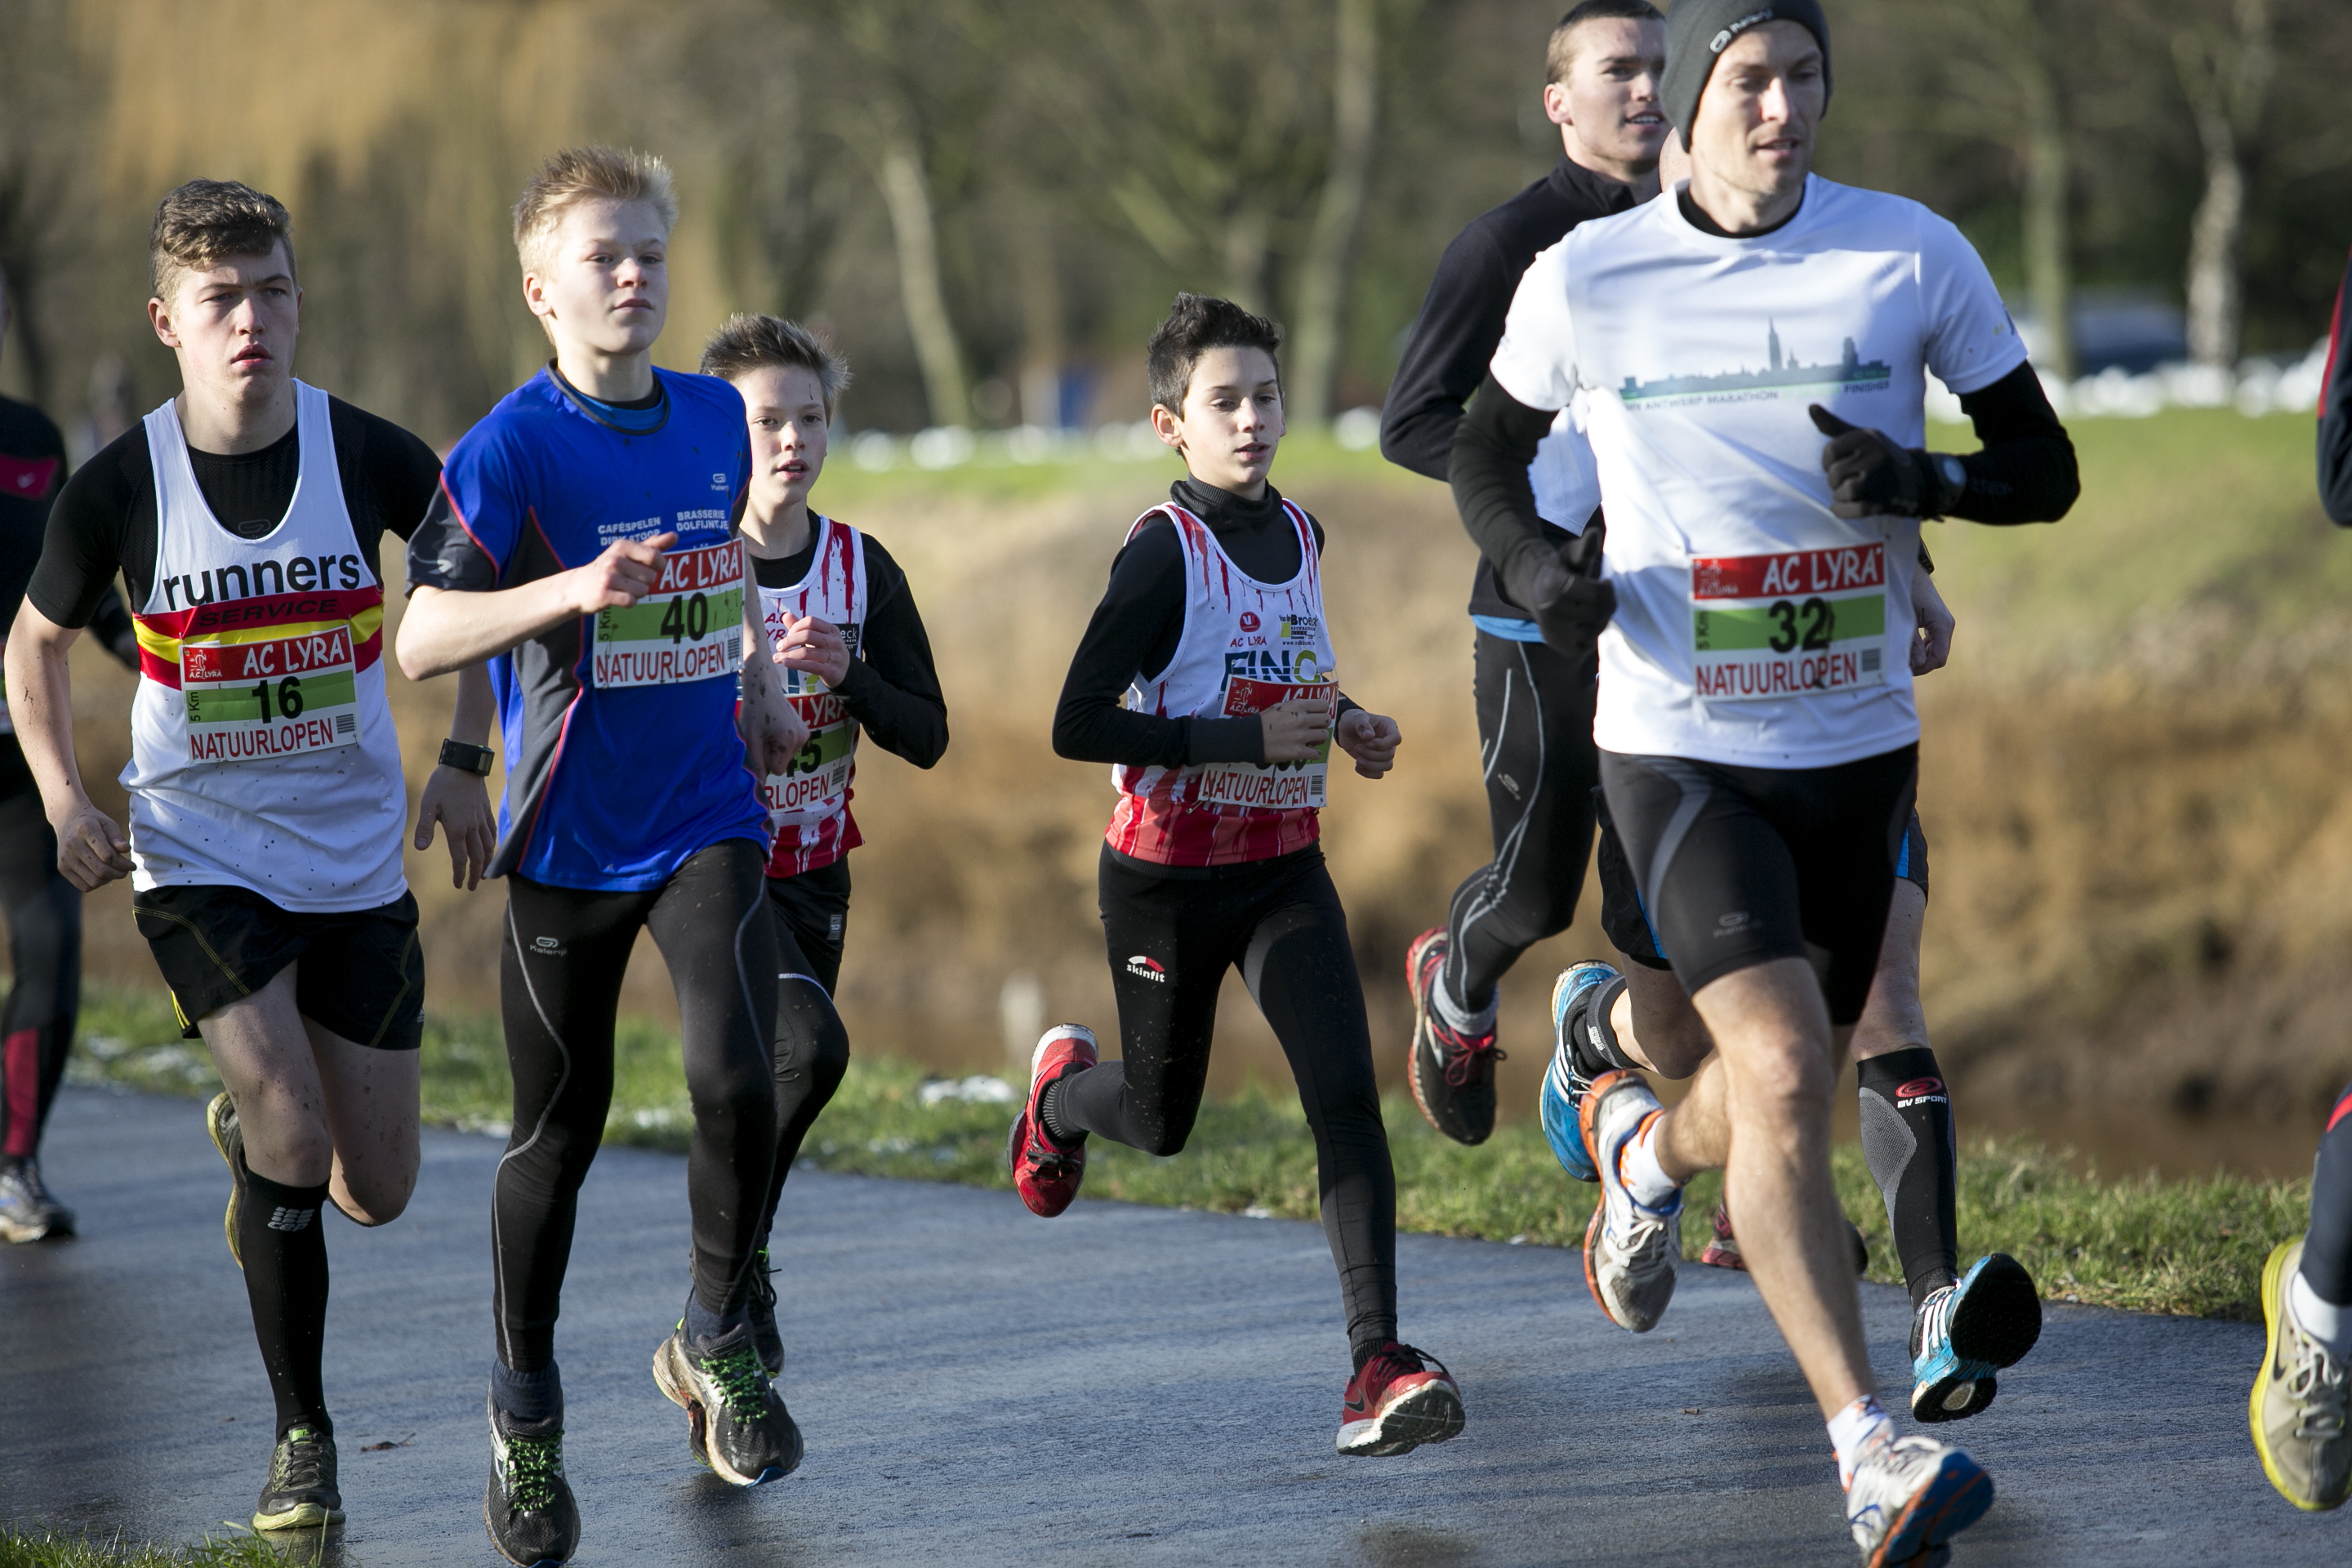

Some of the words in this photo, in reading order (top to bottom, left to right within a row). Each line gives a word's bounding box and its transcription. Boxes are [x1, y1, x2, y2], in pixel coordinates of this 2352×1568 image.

[597, 516, 662, 534] CAFÉSPELEN
[675, 519, 729, 532] DOLFIJNTJE
[676, 510, 725, 521] BRASSERIE
[163, 554, 360, 612] runners
[659, 558, 689, 590] AC
[697, 545, 740, 586] LYRA
[1762, 555, 1800, 595] AC
[1811, 546, 1878, 591] LYRA
[198, 598, 338, 627] SERVICE
[660, 592, 707, 644] 40
[1768, 597, 1829, 654] 32
[840, 627, 857, 639] eck
[1229, 638, 1244, 648] AC
[1247, 635, 1267, 646] LYRA
[244, 644, 274, 676] AC
[284, 632, 345, 672] LYRA
[596, 641, 725, 684] NATUURLOPEN
[204, 670, 222, 679] LYRA
[1695, 653, 1858, 697] NATUURLOPEN
[189, 691, 200, 711] Km
[252, 675, 304, 724] 16
[189, 717, 334, 760] NATUURLOPEN
[763, 773, 830, 811] RLOPEN
[1202, 769, 1309, 805] NATUURLOPEN
[1126, 964, 1165, 982] skinfit
[1896, 1098, 1913, 1109] BV
[1914, 1095, 1948, 1105] SPORT
